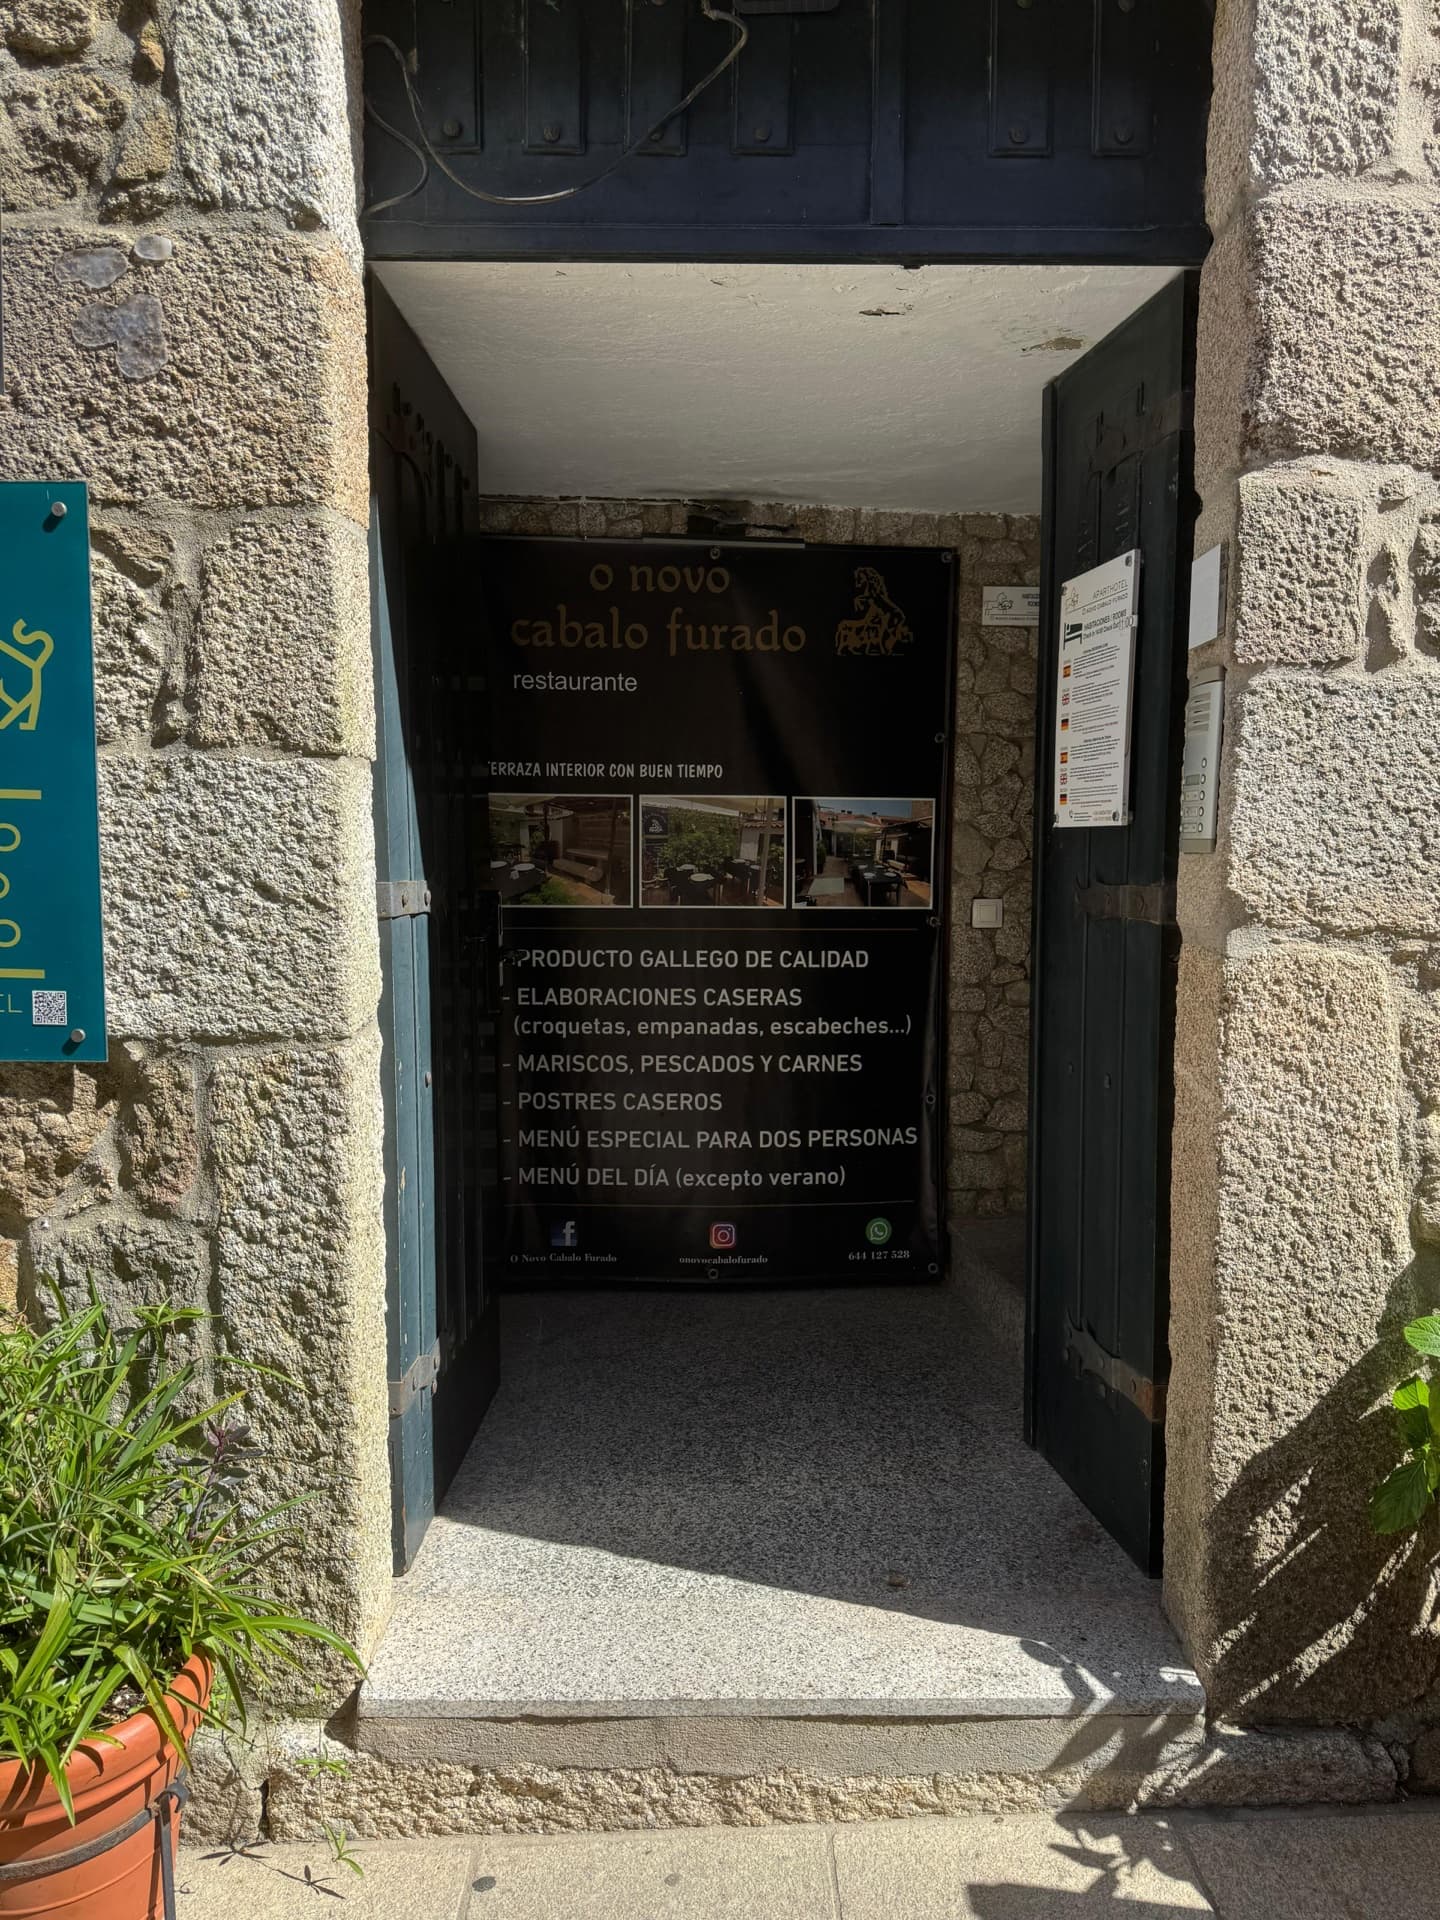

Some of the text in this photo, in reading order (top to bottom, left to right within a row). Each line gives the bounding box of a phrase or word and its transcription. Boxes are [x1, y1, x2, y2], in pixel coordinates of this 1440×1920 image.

[589, 563, 730, 594] o novo
[511, 604, 807, 657] cabalo furado
[513, 671, 638, 692] restaurante
[488, 761, 724, 779] ERRAZA INTERIOR CON BUEN TIEMPO
[516, 949, 869, 969] PRODUCTO GALLEGO DE CALIDAD
[517, 988, 697, 1007] ELABORACIONES
[703, 988, 803, 1007] CASERAS
[513, 1015, 631, 1039] (croquetas,
[637, 1016, 764, 1040] empanadas,
[518, 1054, 634, 1075] MARISCOS,
[640, 1055, 755, 1073] PESCADOS
[760, 1055, 773, 1073] Y
[778, 1055, 863, 1073] CARNES
[518, 1092, 617, 1111] POSTRES
[622, 1092, 723, 1111] CASEROS
[518, 1126, 580, 1148] MENÚ
[587, 1130, 691, 1149] ESPECIAL
[697, 1130, 753, 1149] PARA
[759, 1130, 802, 1149] DOS
[808, 1127, 918, 1148] PERSONAS
[518, 1163, 580, 1185] MENÚ
[587, 1167, 629, 1186] DEL
[635, 1163, 669, 1187] DÍA
[676, 1167, 763, 1190] (excepto
[768, 1165, 846, 1187] verano)
[510, 1252, 617, 1263] O Novo Cabalo Furado
[679, 1254, 769, 1265] onovocabalofurado
